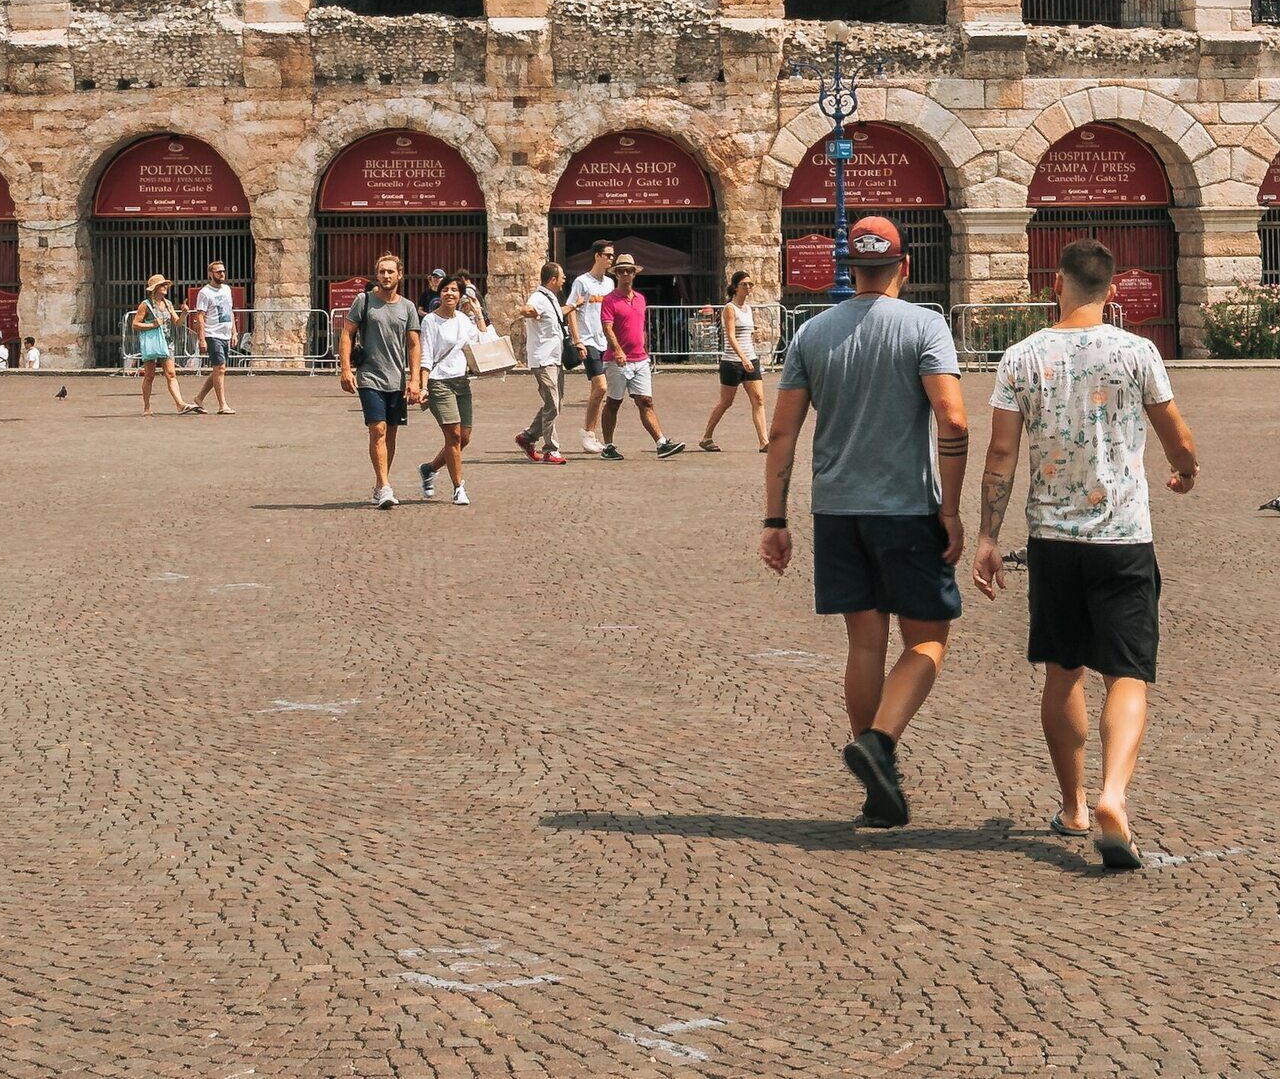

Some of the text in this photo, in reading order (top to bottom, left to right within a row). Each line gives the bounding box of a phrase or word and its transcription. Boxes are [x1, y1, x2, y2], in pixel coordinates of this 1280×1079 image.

[812, 153, 910, 166] GRDINATA
[1049, 151, 1127, 161] HOSPITALITY
[365, 159, 443, 169] BIGLIETTERIA
[578, 162, 677, 174] ARENA SHOP
[1039, 163, 1089, 173] STAMPA
[1102, 163, 1137, 173] PRESS
[139, 164, 213, 176] POLTRONE
[362, 169, 446, 178] TICKET OFFICE
[829, 167, 893, 177] STTORE D
[575, 178, 624, 187] Cancello
[636, 178, 663, 187] Gate
[666, 177, 679, 187] 10
[887, 179, 897, 187] 11
[1047, 174, 1086, 183] Cancello
[1095, 174, 1117, 182] Gate
[1118, 174, 1129, 182] 12
[139, 184, 172, 193] Entrata
[182, 184, 205, 193] Gate
[206, 184, 213, 192] 8
[367, 180, 404, 188] Cancello
[413, 180, 435, 188] Gate
